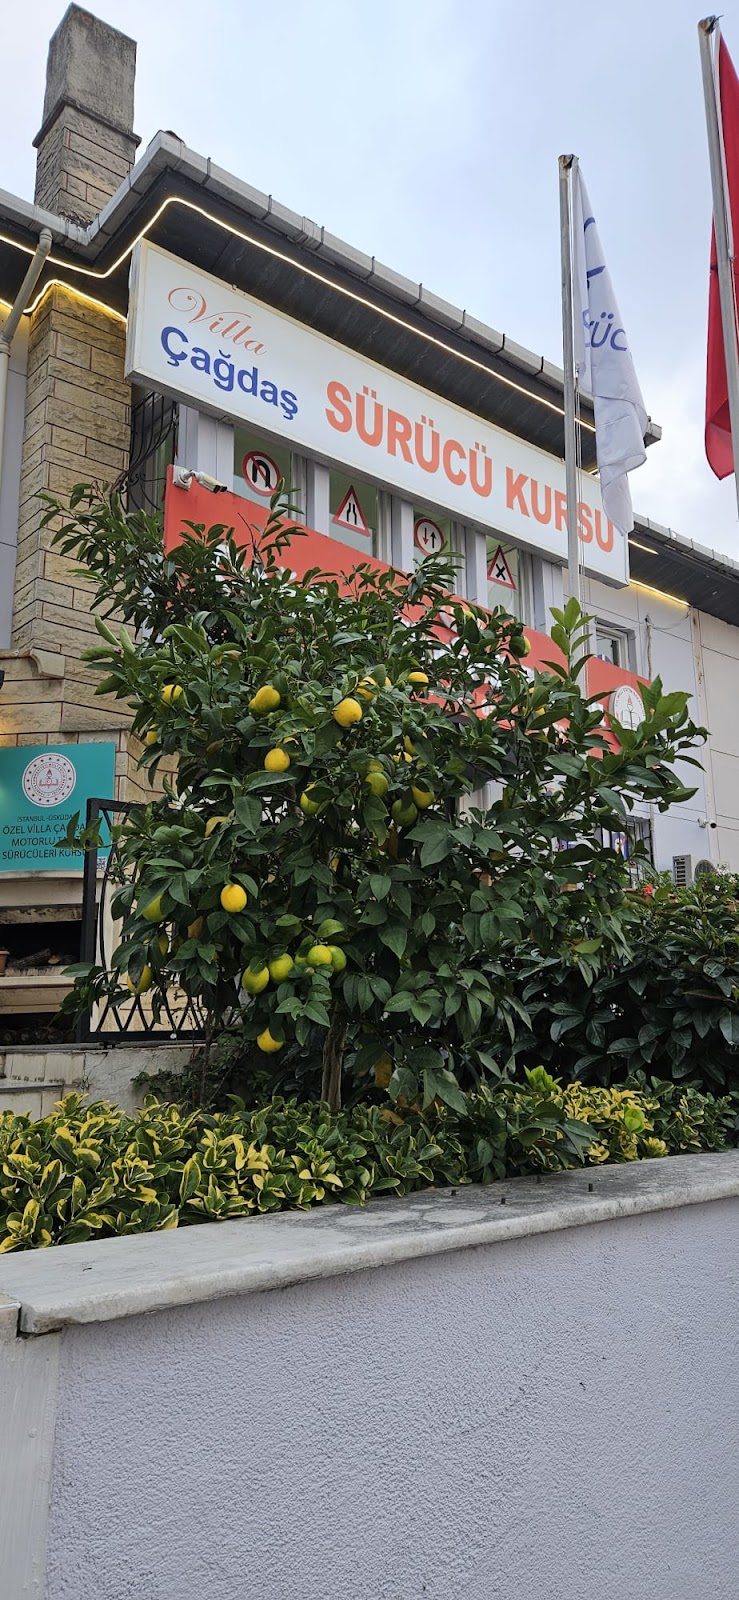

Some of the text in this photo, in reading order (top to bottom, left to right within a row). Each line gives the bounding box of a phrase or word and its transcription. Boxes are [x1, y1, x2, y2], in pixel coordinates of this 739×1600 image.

[167, 287, 267, 356] Villa
[160, 326, 299, 421] Çağdaş
[325, 380, 493, 498] SÜRÜCÜ
[2, 825, 26, 835] ÖZEL
[27, 823, 52, 834] VİLLA
[11, 837, 55, 847] MOTORLU
[2, 848, 85, 860] SÜRÜCÜLERİ KURS
